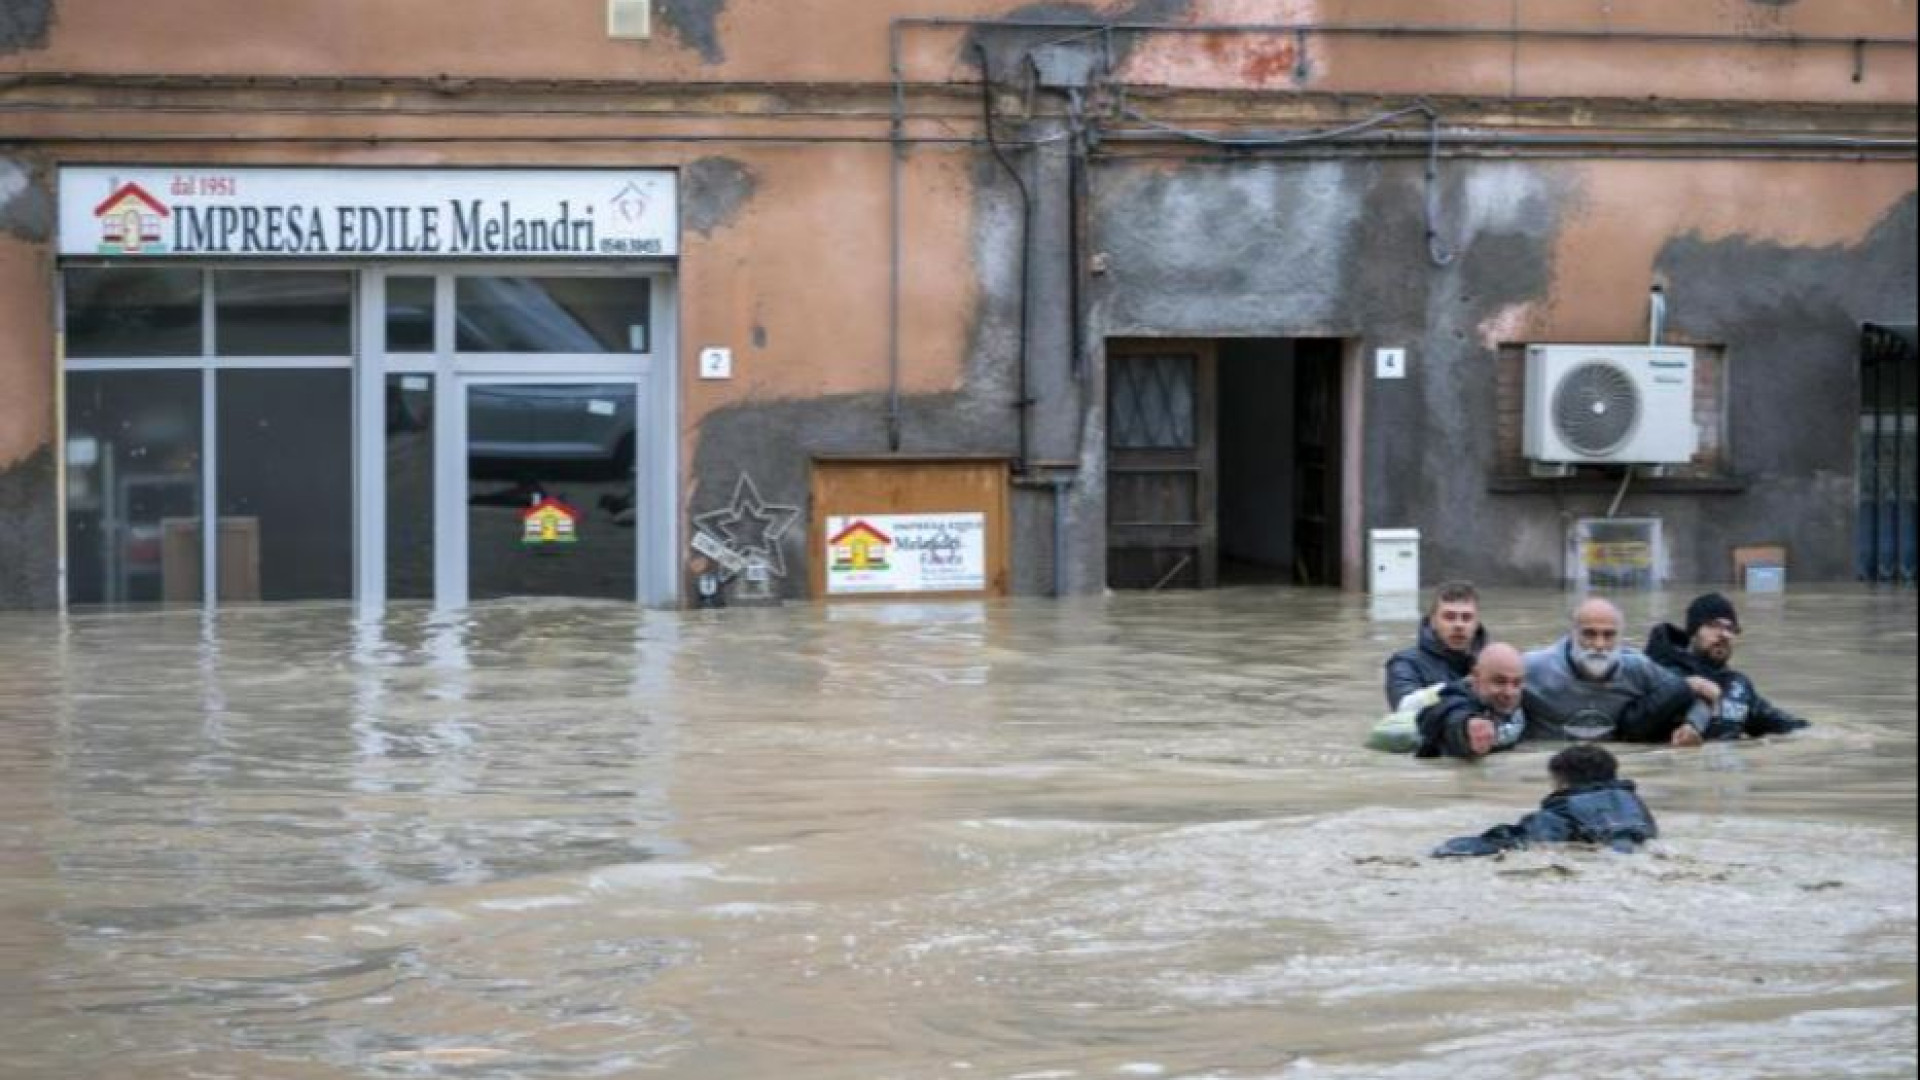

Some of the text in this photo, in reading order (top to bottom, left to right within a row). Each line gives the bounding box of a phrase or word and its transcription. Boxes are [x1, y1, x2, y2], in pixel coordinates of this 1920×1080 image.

[170, 176, 236, 196] dal 1951
[172, 198, 596, 253] IMPRESA EDILE Melandri
[709, 352, 722, 370] 2
